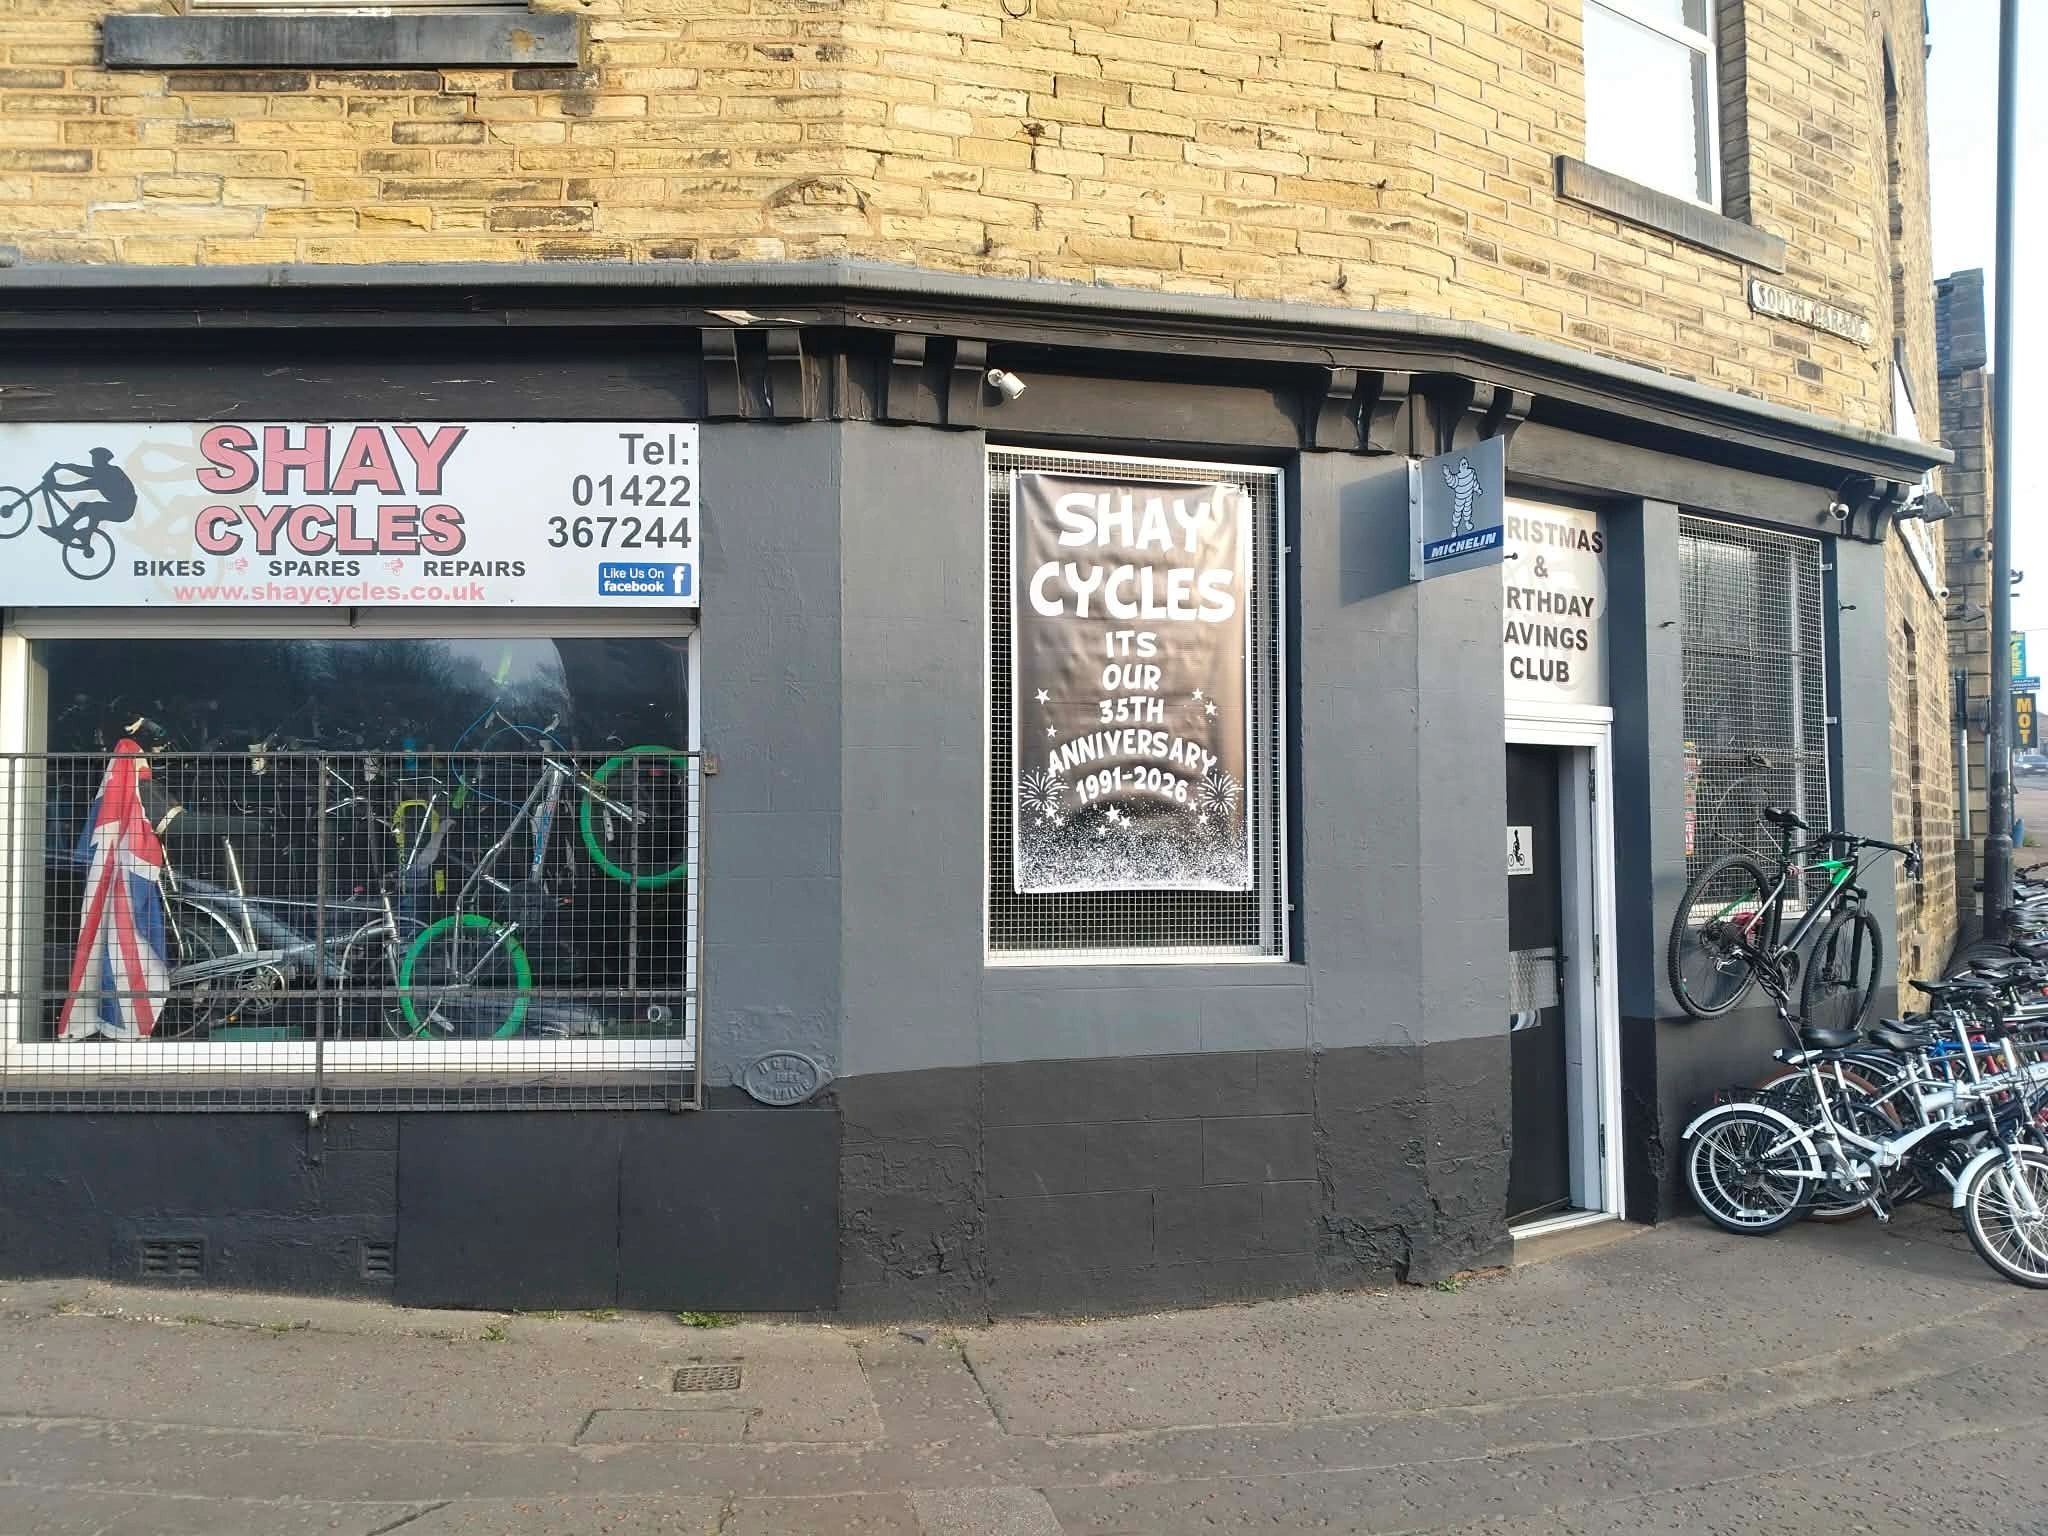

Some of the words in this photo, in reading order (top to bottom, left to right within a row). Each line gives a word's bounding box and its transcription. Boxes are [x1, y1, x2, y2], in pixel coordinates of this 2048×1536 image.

[196, 424, 468, 495] SHAY
[619, 433, 690, 466] Tel:
[571, 474, 692, 508] 01422
[195, 504, 467, 556] CYCLES
[547, 515, 692, 549] 367244
[1055, 492, 1210, 553] SHAY
[1507, 515, 1603, 554] RISTMAS
[1431, 532, 1497, 558] MICHELIN
[132, 560, 206, 577] BIKES
[268, 560, 361, 577] SPARES
[423, 560, 527, 577] REPAIRS
[603, 567, 626, 579] Like
[629, 567, 644, 579] Us
[648, 567, 665, 579] On
[1534, 555, 1548, 579] &
[174, 580, 486, 605] www.shaycycles.co.uk
[603, 580, 665, 592] facebook
[1029, 560, 1236, 623] CYCLES
[1506, 585, 1595, 618] RTHDAY
[1106, 629, 1157, 659] ITS
[1504, 621, 1589, 651] AVINGS
[1102, 664, 1161, 693] OUR
[1509, 655, 1570, 683] CLUB
[1099, 696, 1164, 724] 35TH
[2016, 697, 2032, 745] MOT
[1047, 728, 1219, 779] ANNIVERSARY
[1075, 765, 1189, 805] 1991-2026
